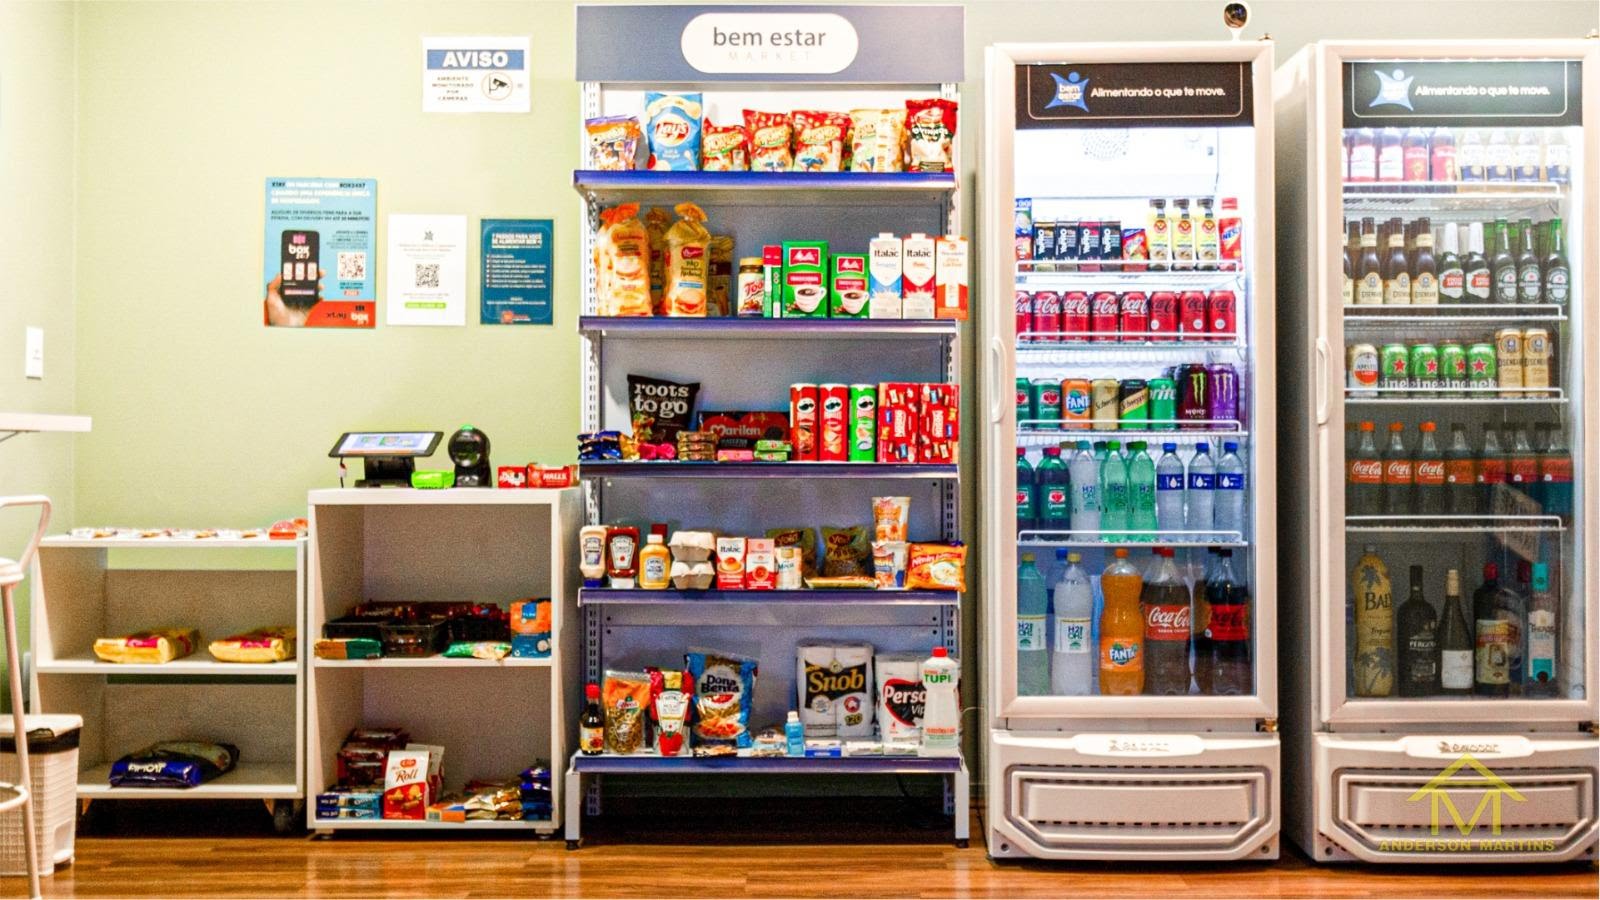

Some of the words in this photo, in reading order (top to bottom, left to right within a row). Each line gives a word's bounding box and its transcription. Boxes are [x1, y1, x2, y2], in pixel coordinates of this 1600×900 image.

[713, 27, 762, 47] bem
[770, 29, 827, 47] estar
[442, 51, 509, 68] AVISO
[728, 51, 812, 62] MARKET
[1090, 87, 1153, 98] Alimentando
[1155, 89, 1161, 97] o
[1163, 89, 1182, 98] que
[1184, 87, 1194, 96] te
[1196, 87, 1226, 97] move.
[1415, 85, 1478, 96] Alimentando
[1479, 88, 1486, 97] o
[1487, 88, 1507, 98] que
[1508, 86, 1519, 96] te
[874, 248, 899, 258] Italac
[906, 248, 932, 258] Italac
[634, 383, 689, 398] roots
[634, 394, 658, 412] to
[659, 400, 688, 419] go
[710, 424, 761, 437] Marilan
[542, 473, 568, 481] HALLS
[706, 675, 737, 687] Dona
[808, 668, 864, 693] Snob
[923, 673, 951, 684] TUPI
[701, 682, 740, 694] Benta
[396, 768, 418, 783] Roll
